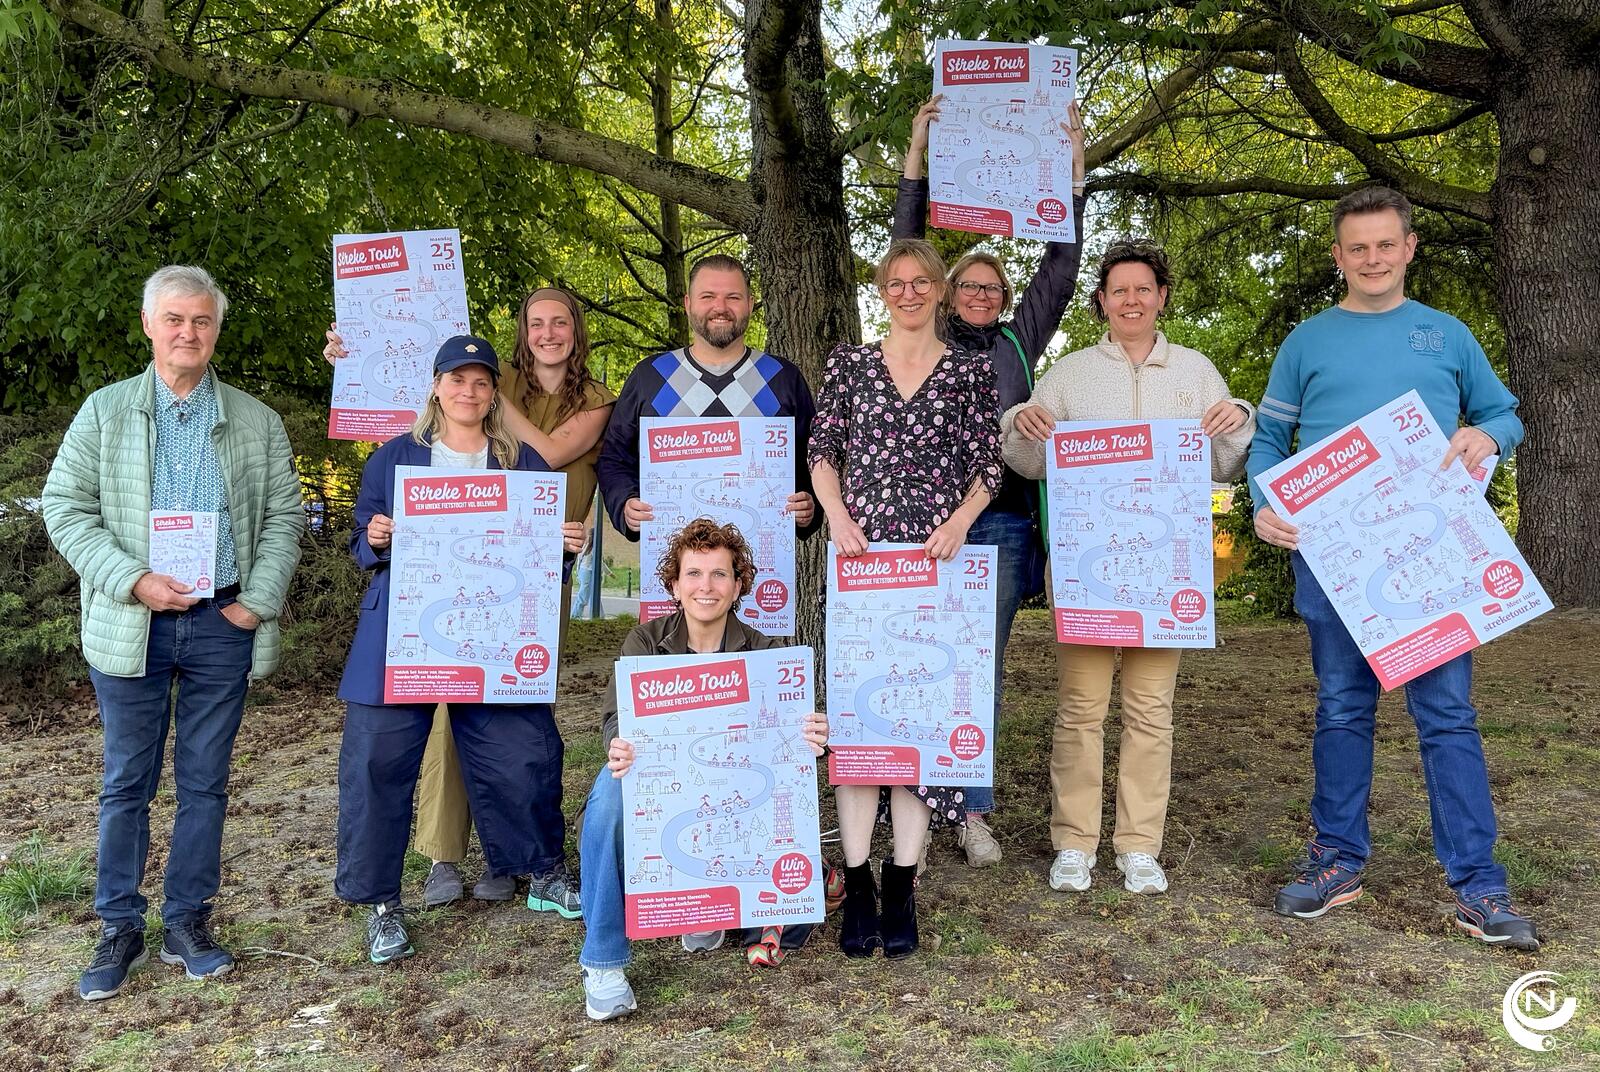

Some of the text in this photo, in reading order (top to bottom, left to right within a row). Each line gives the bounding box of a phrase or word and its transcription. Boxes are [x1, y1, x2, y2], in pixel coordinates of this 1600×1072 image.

[947, 55, 1026, 72] Streke Tour
[1052, 60, 1071, 76] 25
[1052, 78, 1070, 86] mei
[1043, 201, 1062, 209] Win
[338, 245, 401, 266] Streke Tour
[430, 242, 454, 260] 25
[433, 260, 456, 270] mei
[1392, 406, 1423, 432] 25
[653, 430, 736, 449] Streke Tour
[765, 430, 788, 447] 25
[1178, 433, 1203, 450] 25
[1405, 424, 1432, 445] mei
[1060, 433, 1147, 454] Streke Tour
[765, 448, 787, 457] mei
[1179, 451, 1203, 461] mei
[1281, 439, 1366, 499] Streke Tour
[410, 483, 502, 501] Streke Tour
[534, 487, 558, 504] 25
[533, 506, 557, 515] mei
[842, 558, 932, 577] Streke Tour
[964, 560, 989, 578] 25
[1487, 564, 1512, 581] Win
[763, 583, 783, 594] Win
[964, 579, 988, 588] mei
[1178, 593, 1200, 604] Win
[1506, 590, 1536, 608] Meer info
[1484, 598, 1542, 632] streketour.be
[523, 648, 544, 659] Win
[638, 671, 742, 699] Streke Tour
[778, 666, 805, 688] 25
[779, 688, 805, 701] mei
[958, 728, 980, 740] Win
[781, 857, 806, 871] Win
[752, 905, 814, 918] streketour.be
